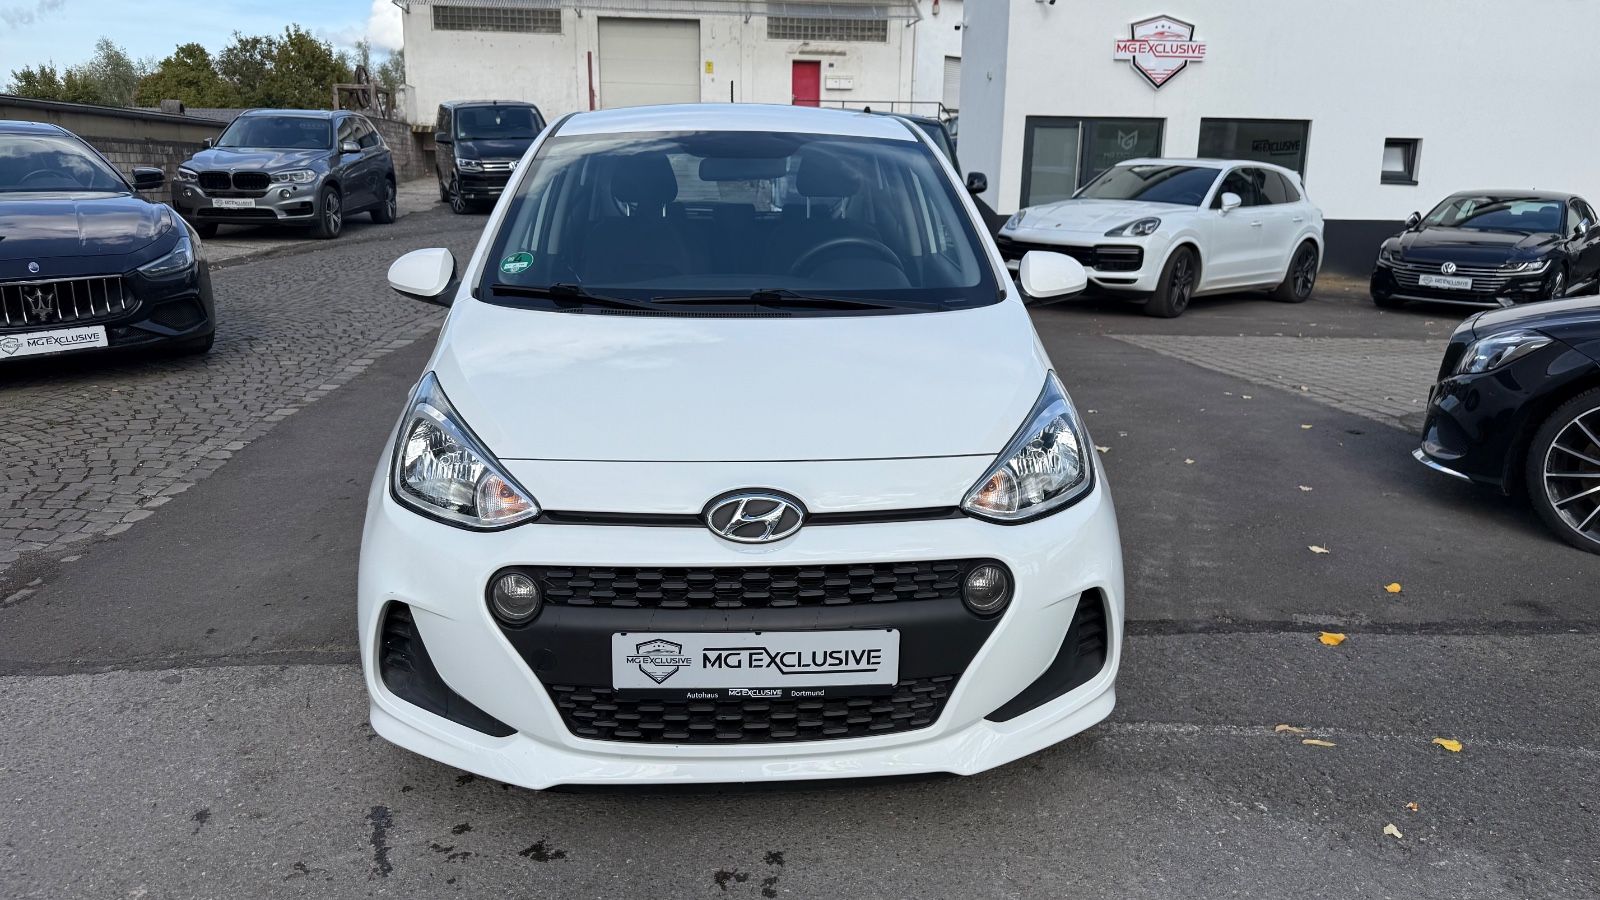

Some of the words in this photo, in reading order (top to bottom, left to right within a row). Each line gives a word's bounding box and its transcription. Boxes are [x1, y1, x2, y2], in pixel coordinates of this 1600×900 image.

[1116, 43, 1137, 53] MG
[1138, 43, 1206, 55] EXCLUSIVE
[27, 339, 45, 347] MG
[46, 333, 100, 345] EXCLUSIVE
[702, 652, 742, 669] MG
[748, 649, 882, 669] EXCLUSIVE
[686, 691, 719, 699] Autohaus
[741, 689, 782, 697] EXCLUSIVE
[791, 689, 825, 697] Dortmund
